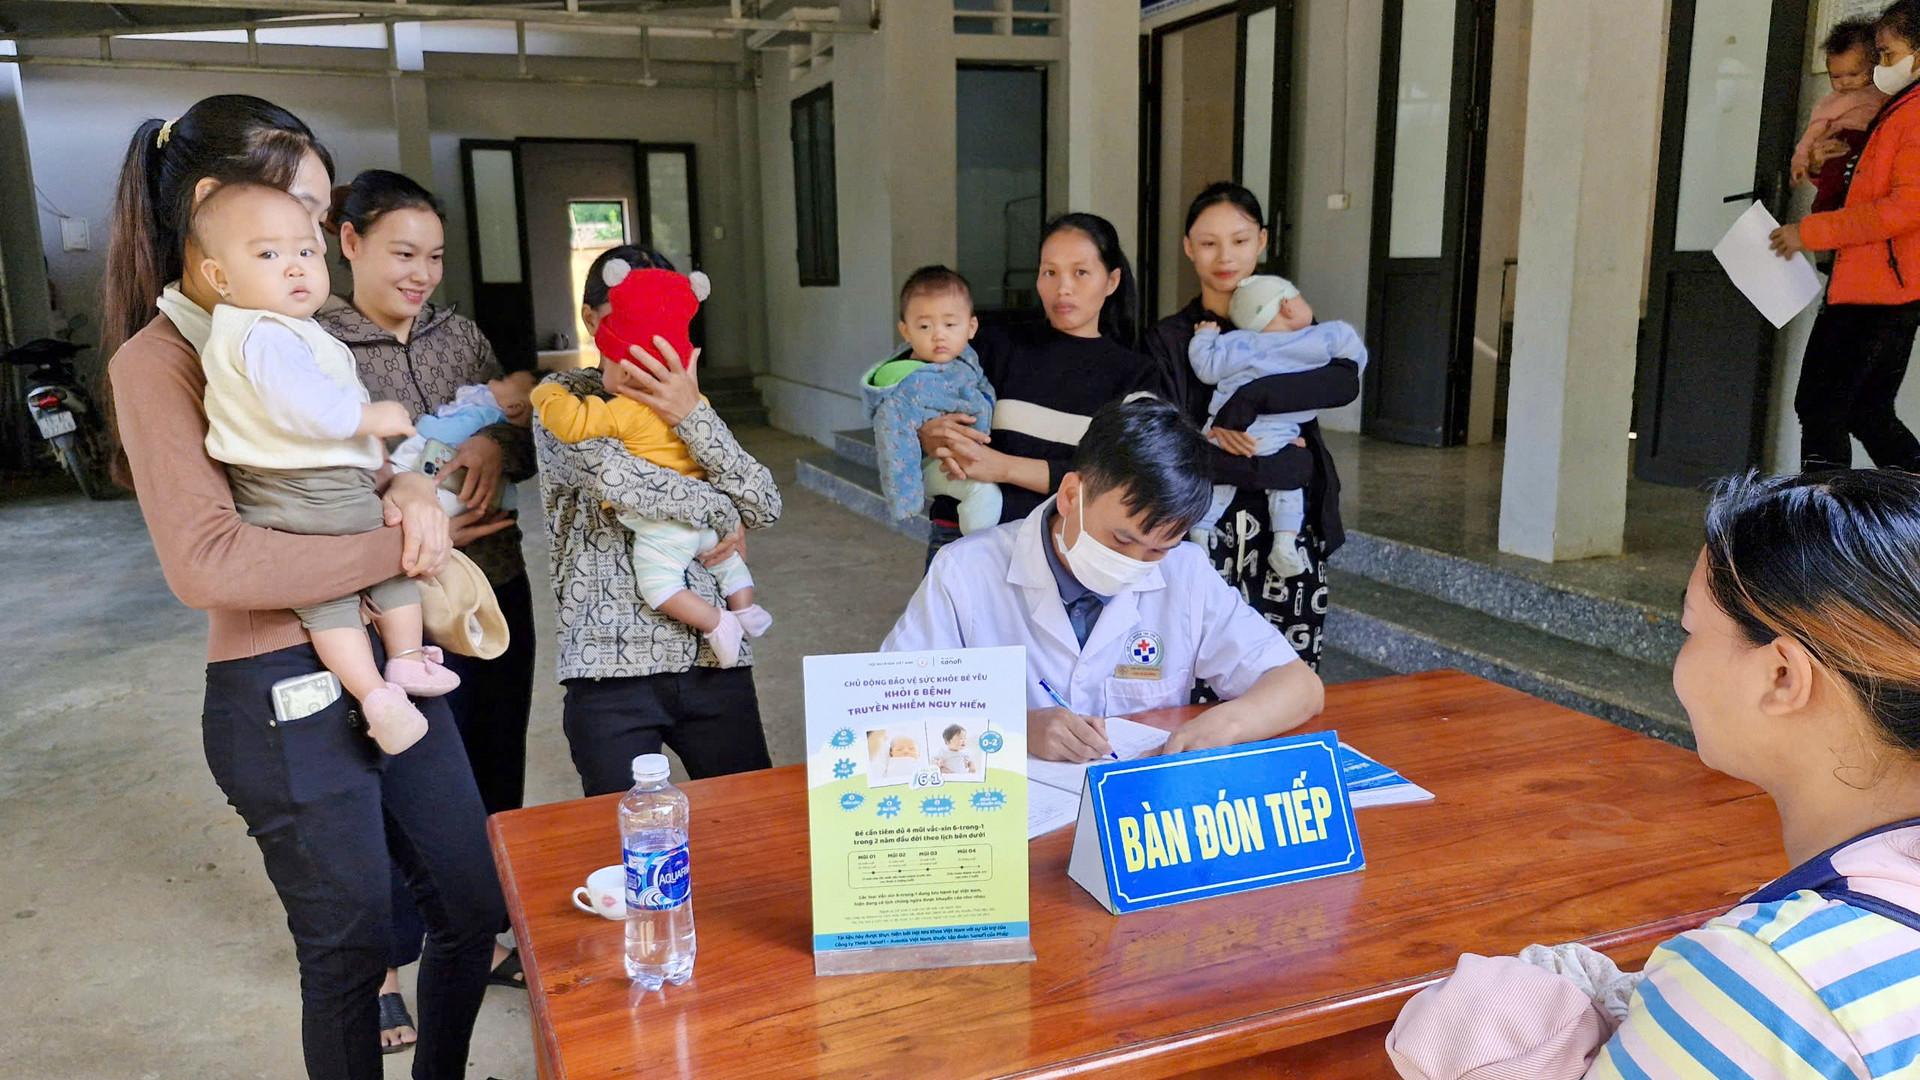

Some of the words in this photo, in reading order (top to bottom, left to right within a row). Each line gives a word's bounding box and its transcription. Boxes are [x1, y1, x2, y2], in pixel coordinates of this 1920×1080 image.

[844, 678, 861, 687] CHỦ
[863, 678, 887, 688] ĐỘNG
[888, 676, 905, 685] BẢO
[972, 673, 988, 681] YÊU
[884, 687, 911, 698] KHỎI
[922, 685, 951, 697] BỆNH
[848, 701, 889, 715] TRUYỀN
[892, 698, 926, 710] NHIỄM
[952, 823, 985, 831] 6-trong-1
[1118, 801, 1192, 873] BÀN
[1192, 789, 1265, 860] ĐÓN
[1264, 771, 1332, 847] TIẾP
